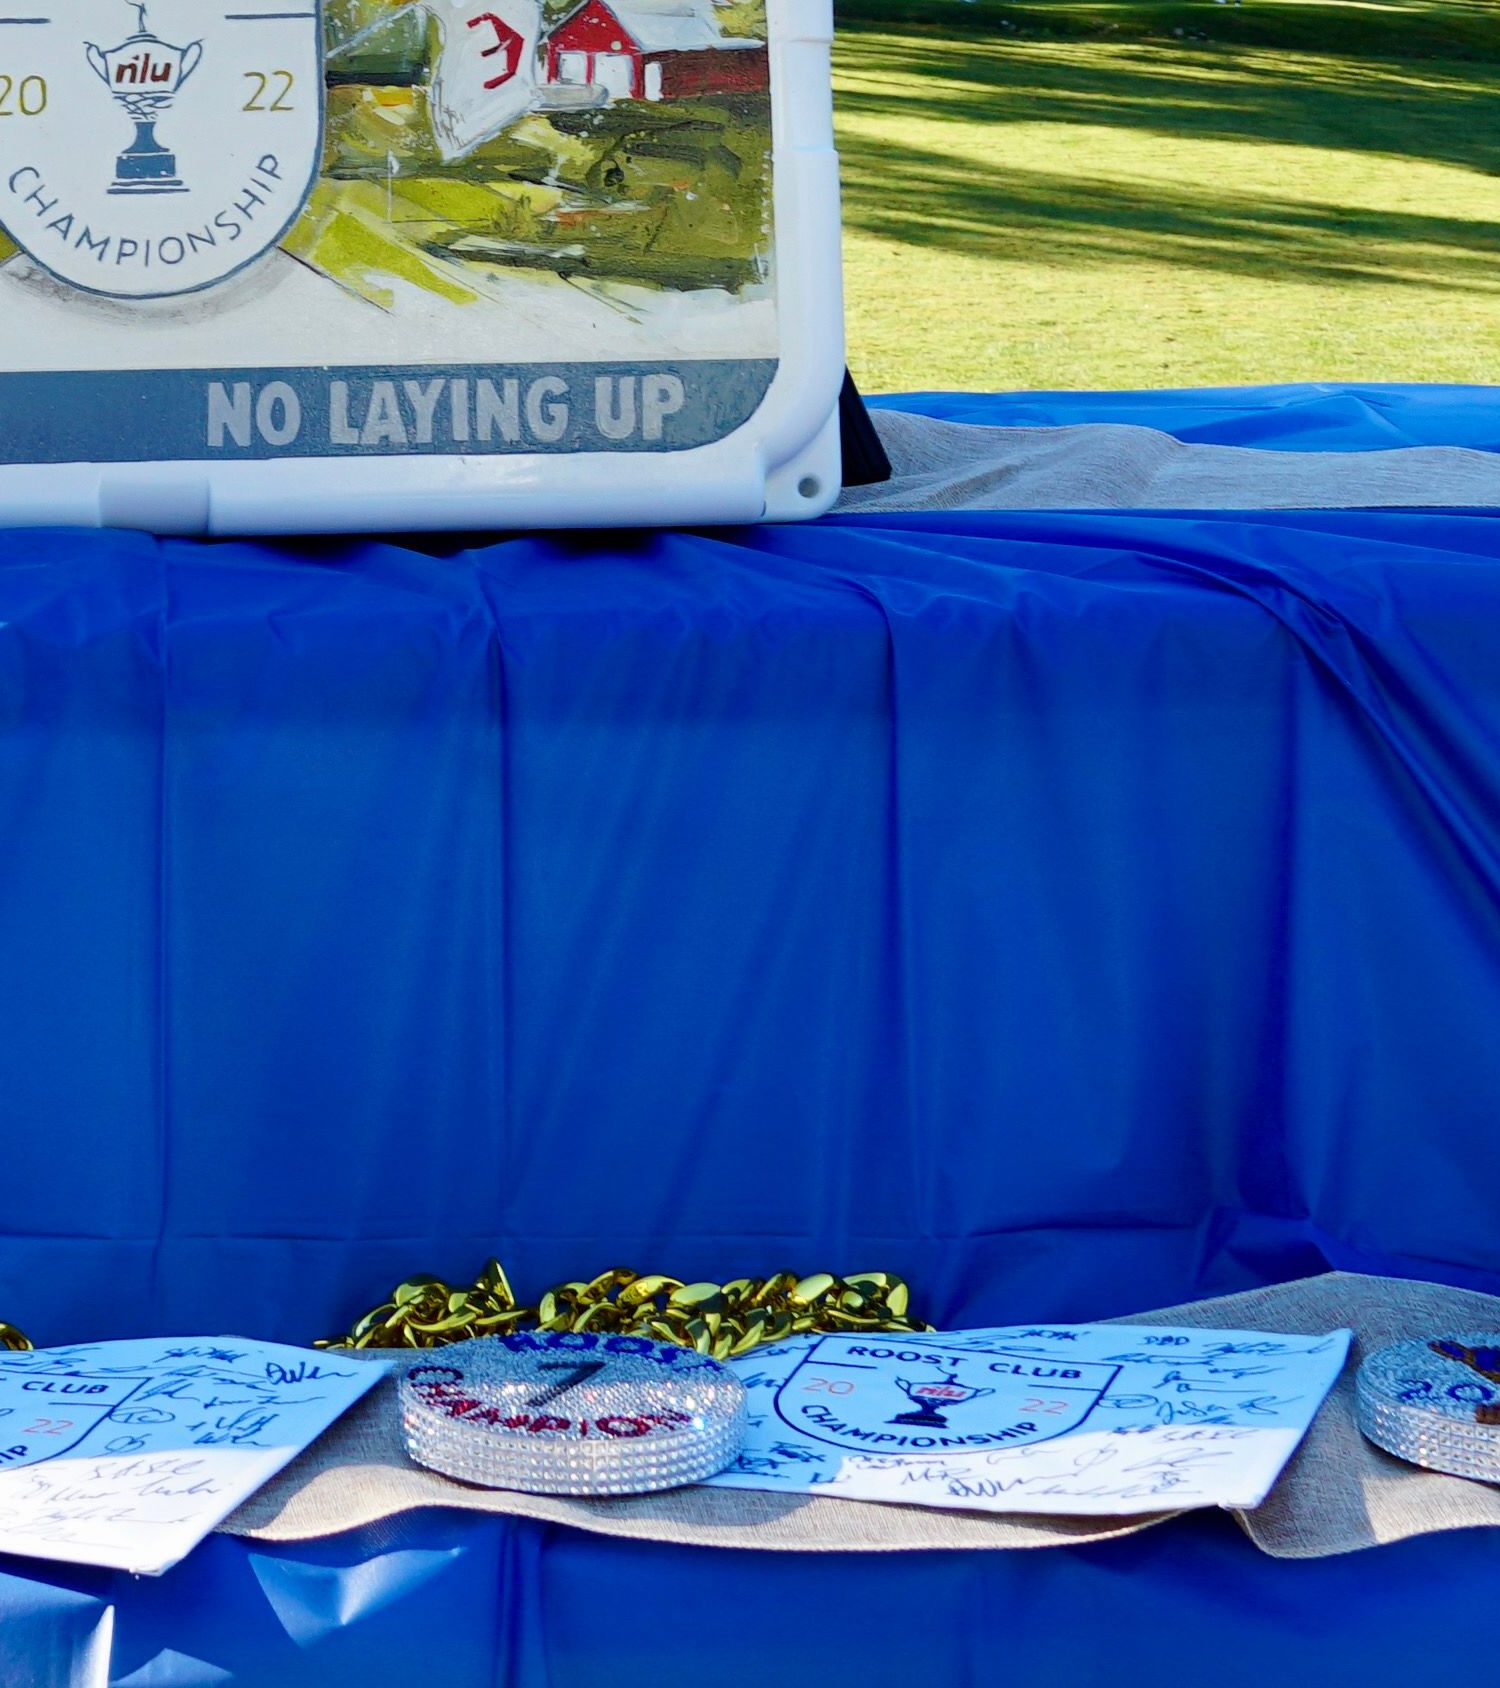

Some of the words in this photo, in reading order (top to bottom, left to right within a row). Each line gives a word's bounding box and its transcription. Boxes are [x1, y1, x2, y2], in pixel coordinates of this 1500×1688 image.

[242, 70, 295, 112] 22
[8, 153, 283, 267] CHAMPIONSHIP
[206, 381, 301, 447] NO
[329, 375, 570, 446] LAYING
[594, 373, 685, 441] UP
[846, 1345, 970, 1368] ROOST
[987, 1362, 1083, 1379] CLUB
[21, 1380, 109, 1394] CLUB
[526, 1361, 606, 1408] 7
[801, 1377, 856, 1396] 20
[1017, 1398, 1070, 1415] 22
[22, 1418, 74, 1435] 22
[800, 1404, 1040, 1448] CHAMPIONSHIP
